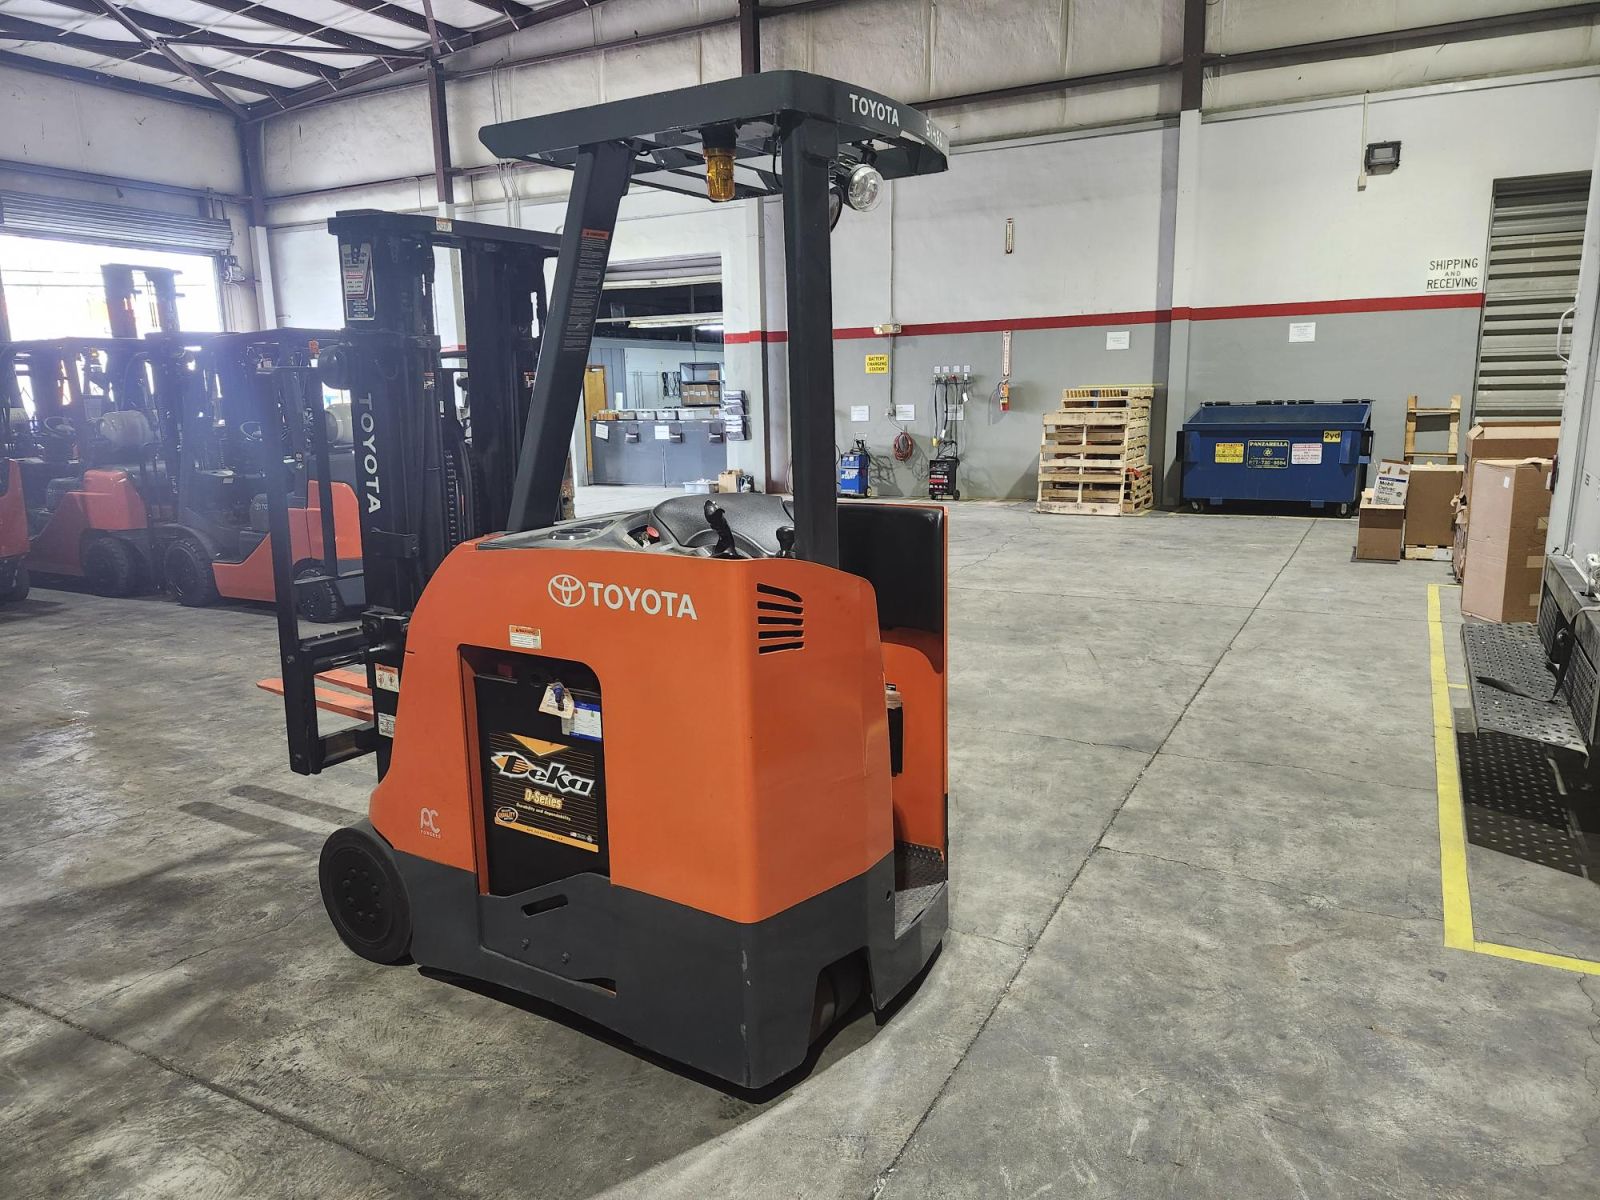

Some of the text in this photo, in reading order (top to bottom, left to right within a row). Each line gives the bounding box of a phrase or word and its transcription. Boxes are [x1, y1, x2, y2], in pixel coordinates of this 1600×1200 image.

[849, 93, 900, 127] TOYOTA
[1429, 258, 1478, 271] SHIPPING
[1426, 277, 1478, 290] RECEIVING
[1324, 431, 1340, 440] 2yd
[359, 392, 381, 514] TOYOTA
[588, 581, 698, 621] TOYOTA
[491, 752, 595, 796] Deka
[524, 788, 563, 810] D-Series
